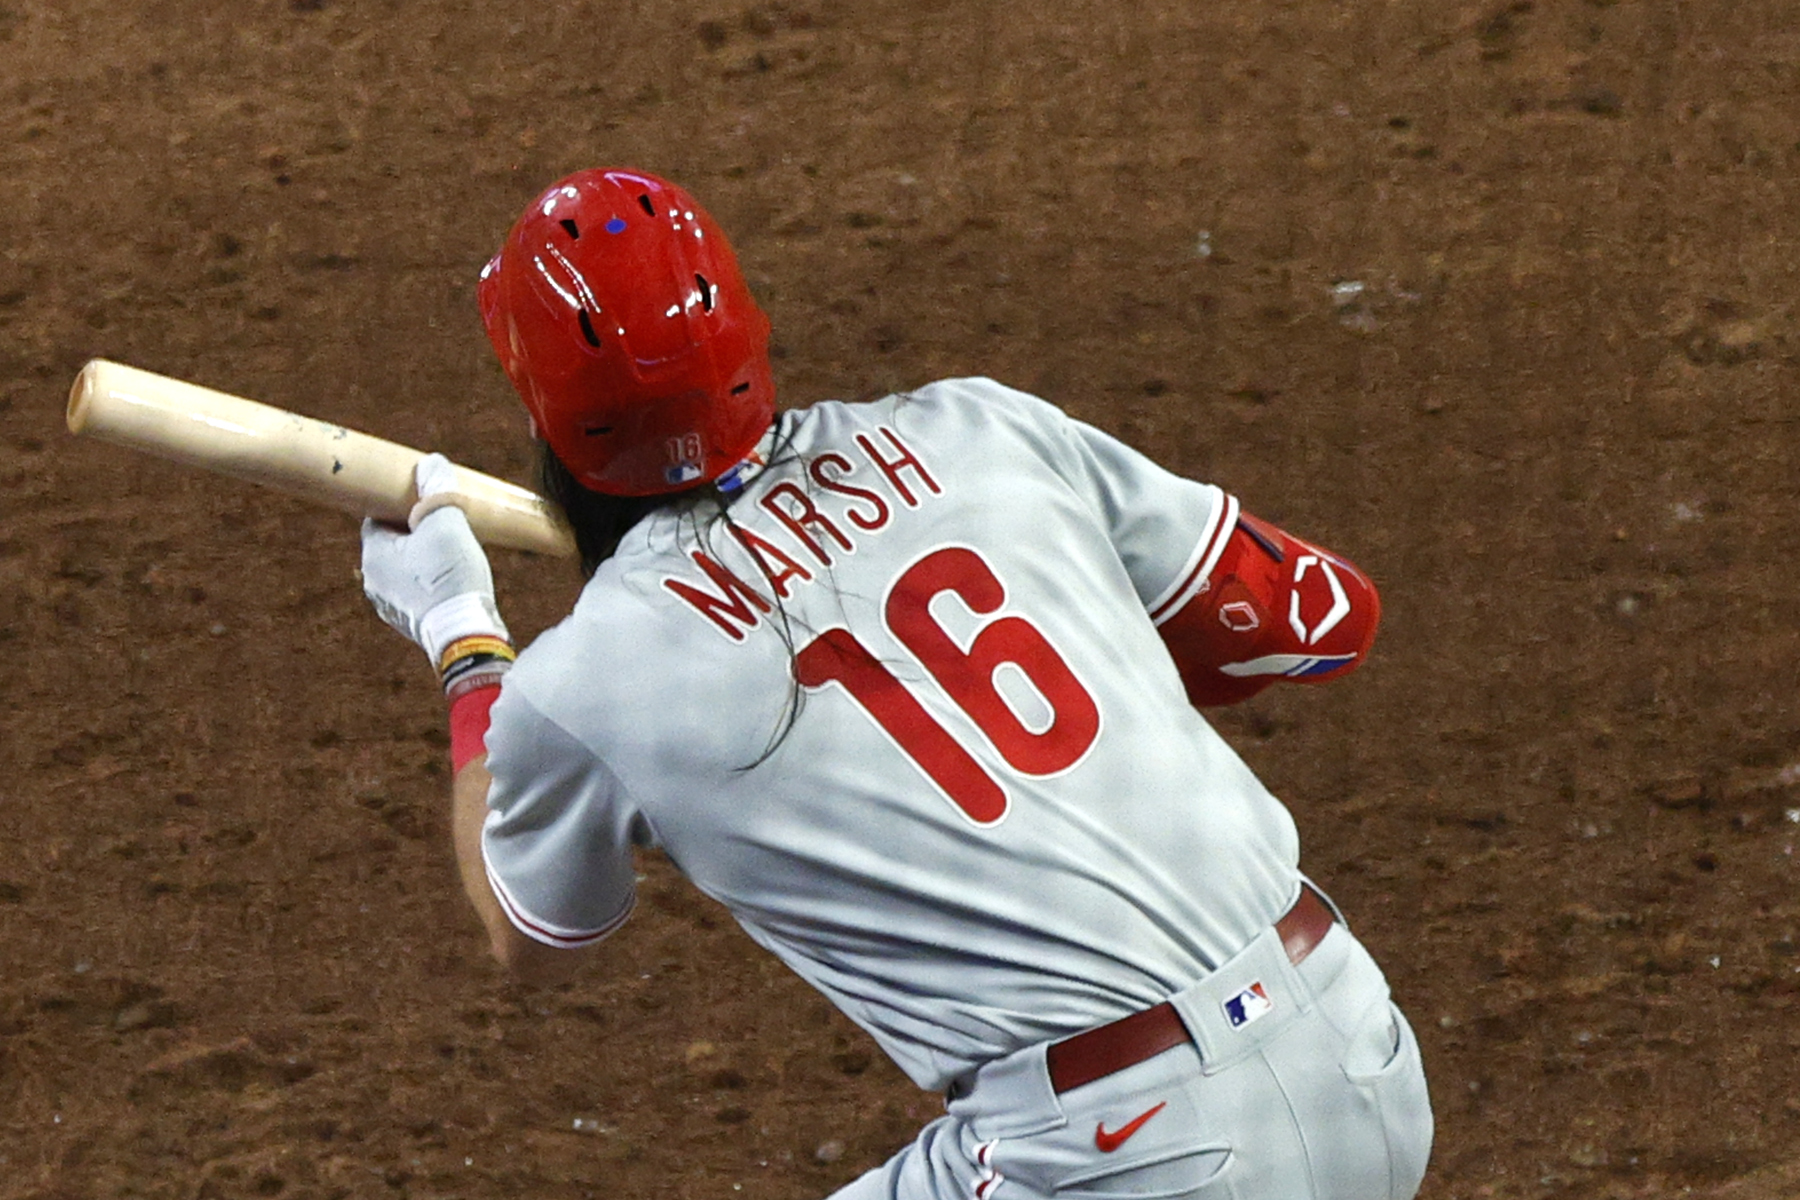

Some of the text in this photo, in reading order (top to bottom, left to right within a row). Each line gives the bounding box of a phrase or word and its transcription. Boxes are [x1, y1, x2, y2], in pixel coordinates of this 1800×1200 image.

[662, 426, 944, 643] MARSH
[665, 432, 703, 463] 16
[790, 542, 1103, 827] 16
